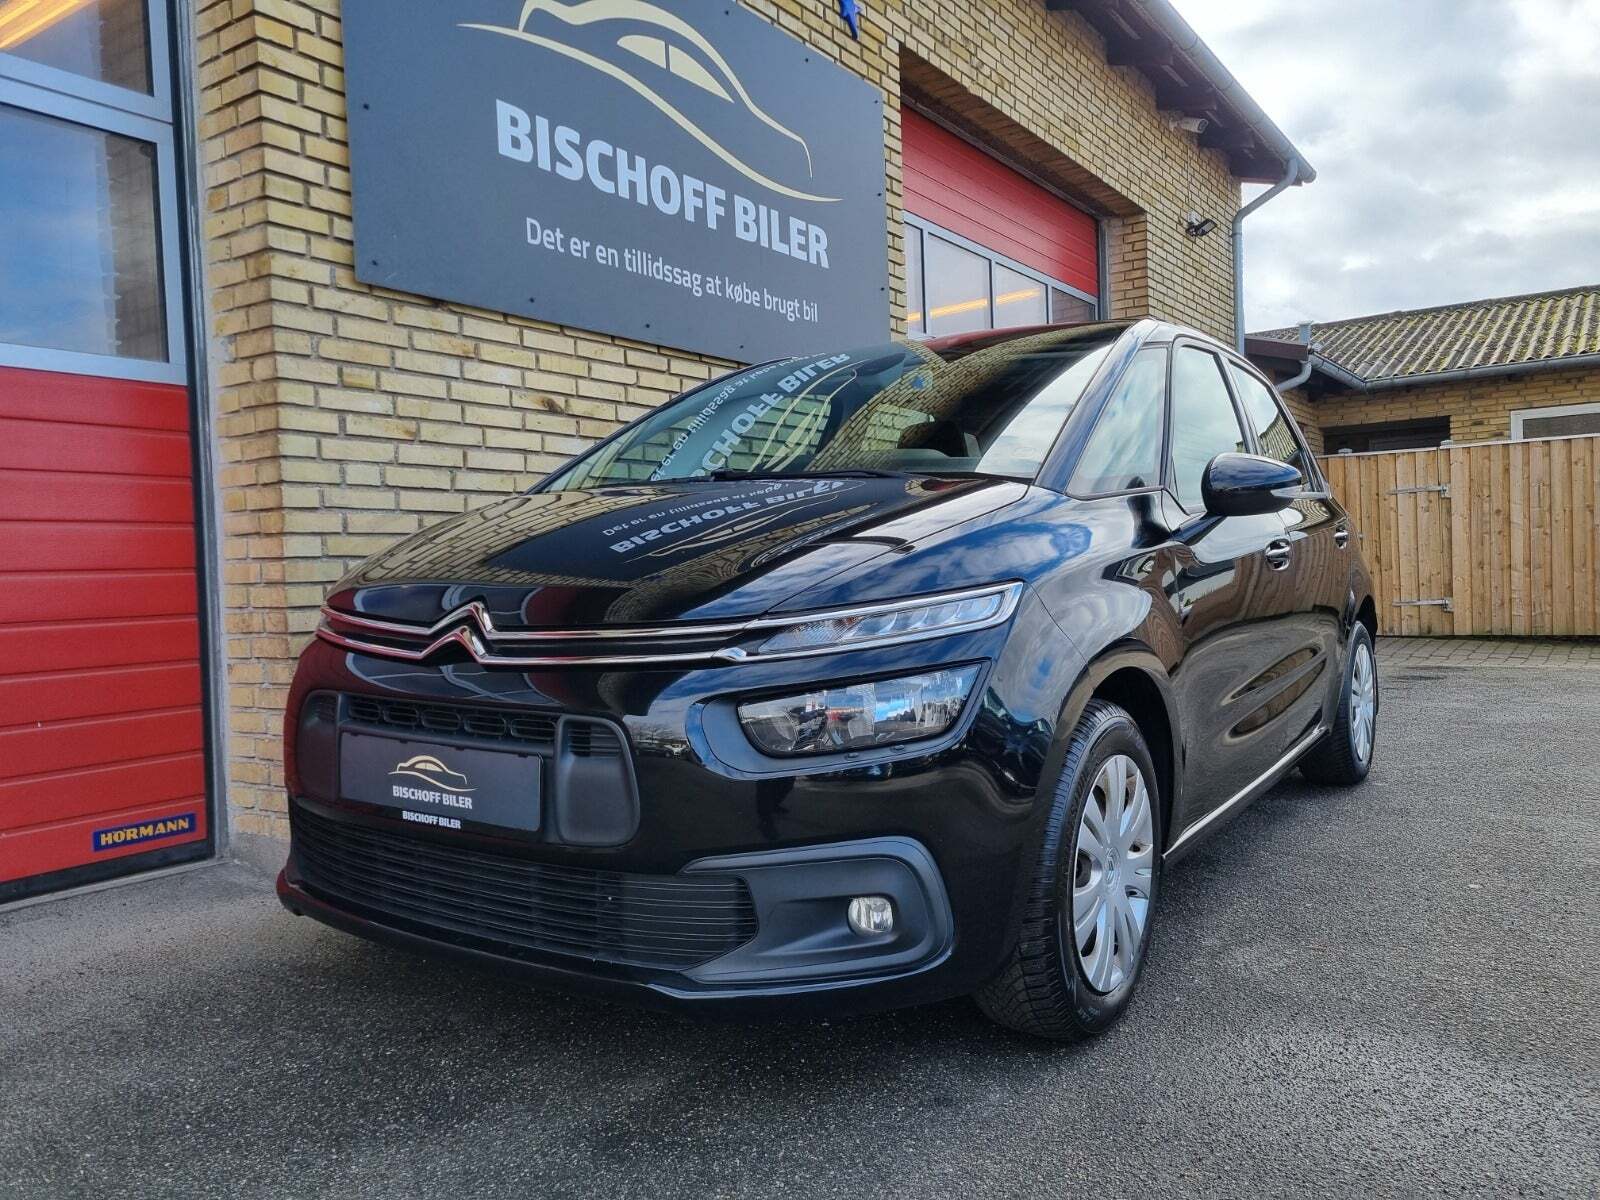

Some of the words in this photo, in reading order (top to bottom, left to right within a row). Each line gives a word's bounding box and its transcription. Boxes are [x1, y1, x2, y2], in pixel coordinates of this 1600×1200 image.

[496, 98, 727, 231] BISCHOFF
[734, 195, 830, 270] BILER
[526, 216, 565, 253] Det
[570, 236, 591, 259] er
[595, 244, 619, 268] en
[624, 247, 703, 297] tillidssag
[706, 275, 722, 297] at
[725, 277, 761, 307] købe
[764, 288, 801, 322] brugt
[803, 299, 818, 322] bil
[392, 785, 441, 804] BISCHOFF
[442, 793, 473, 809] BILER
[402, 810, 439, 826] BISCHOFF
[438, 816, 462, 830] BILER
